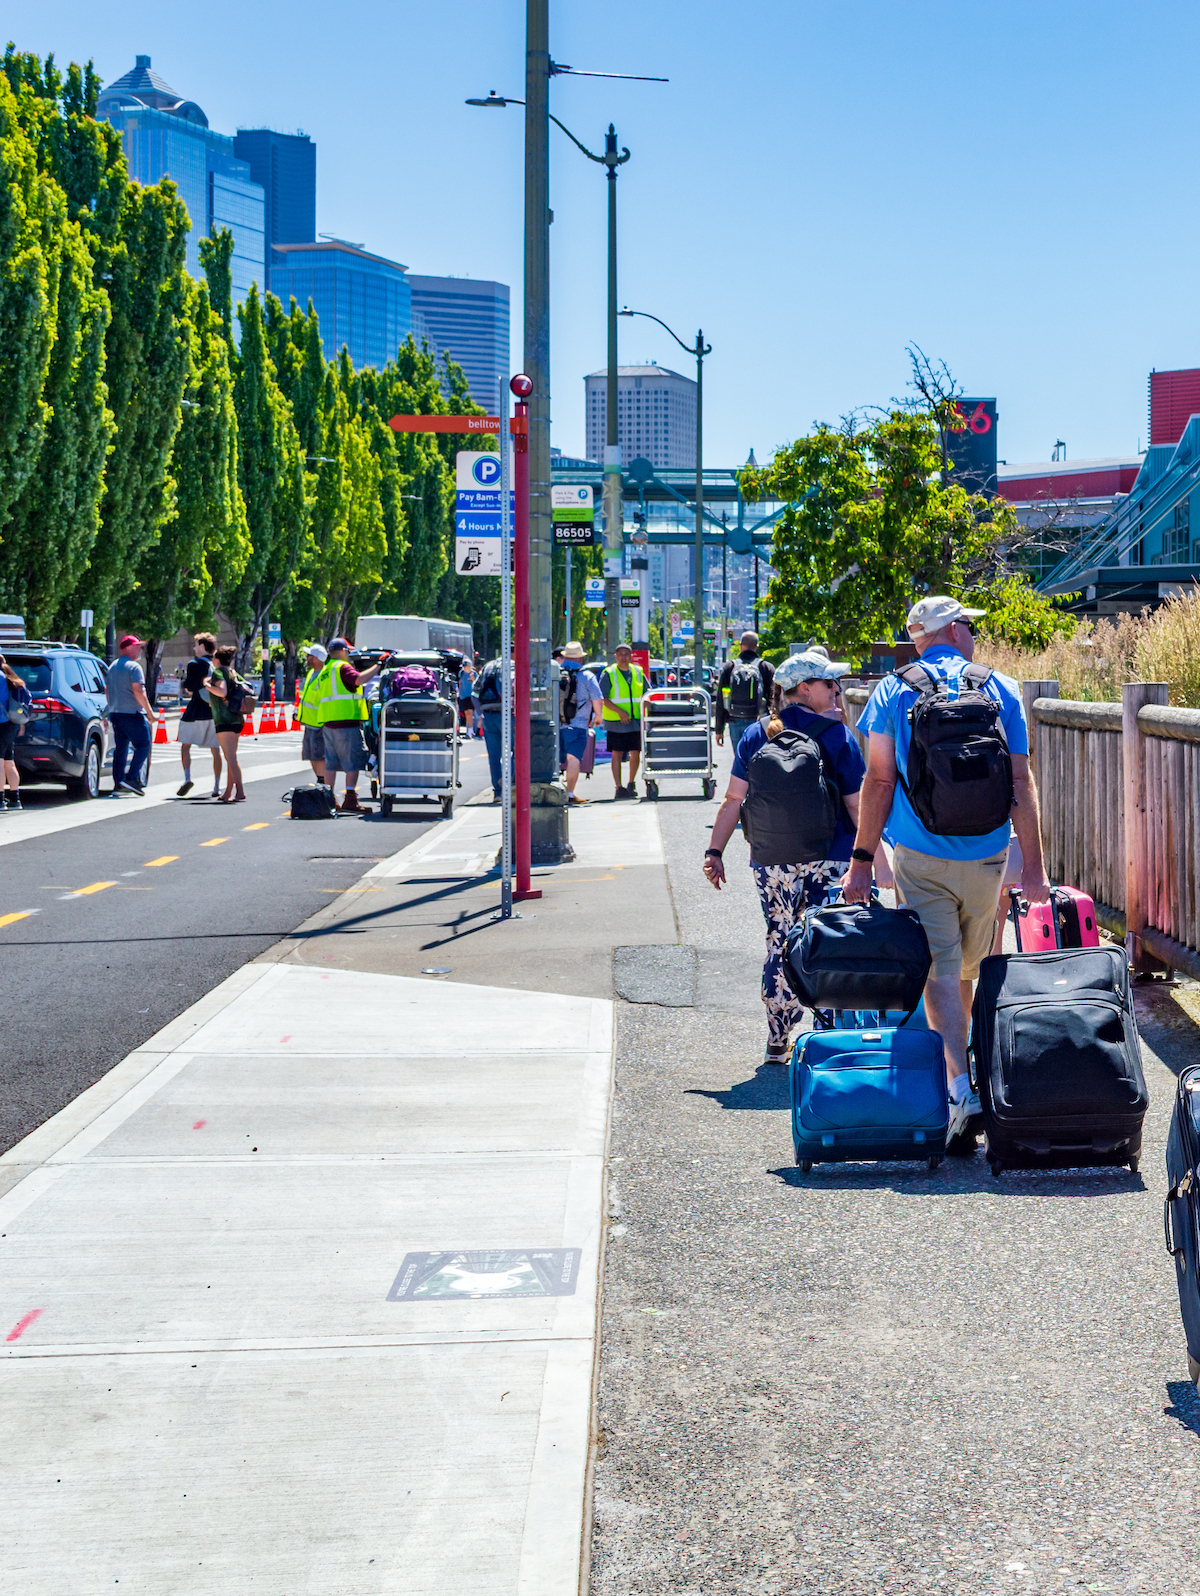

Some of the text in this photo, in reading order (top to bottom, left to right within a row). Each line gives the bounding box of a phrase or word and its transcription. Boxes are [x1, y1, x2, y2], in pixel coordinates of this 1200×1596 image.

[468, 419, 501, 429] belltow
[459, 492, 475, 502] Pay
[458, 518, 514, 531] 4 Hours Mx
[555, 528, 592, 538] 86505
